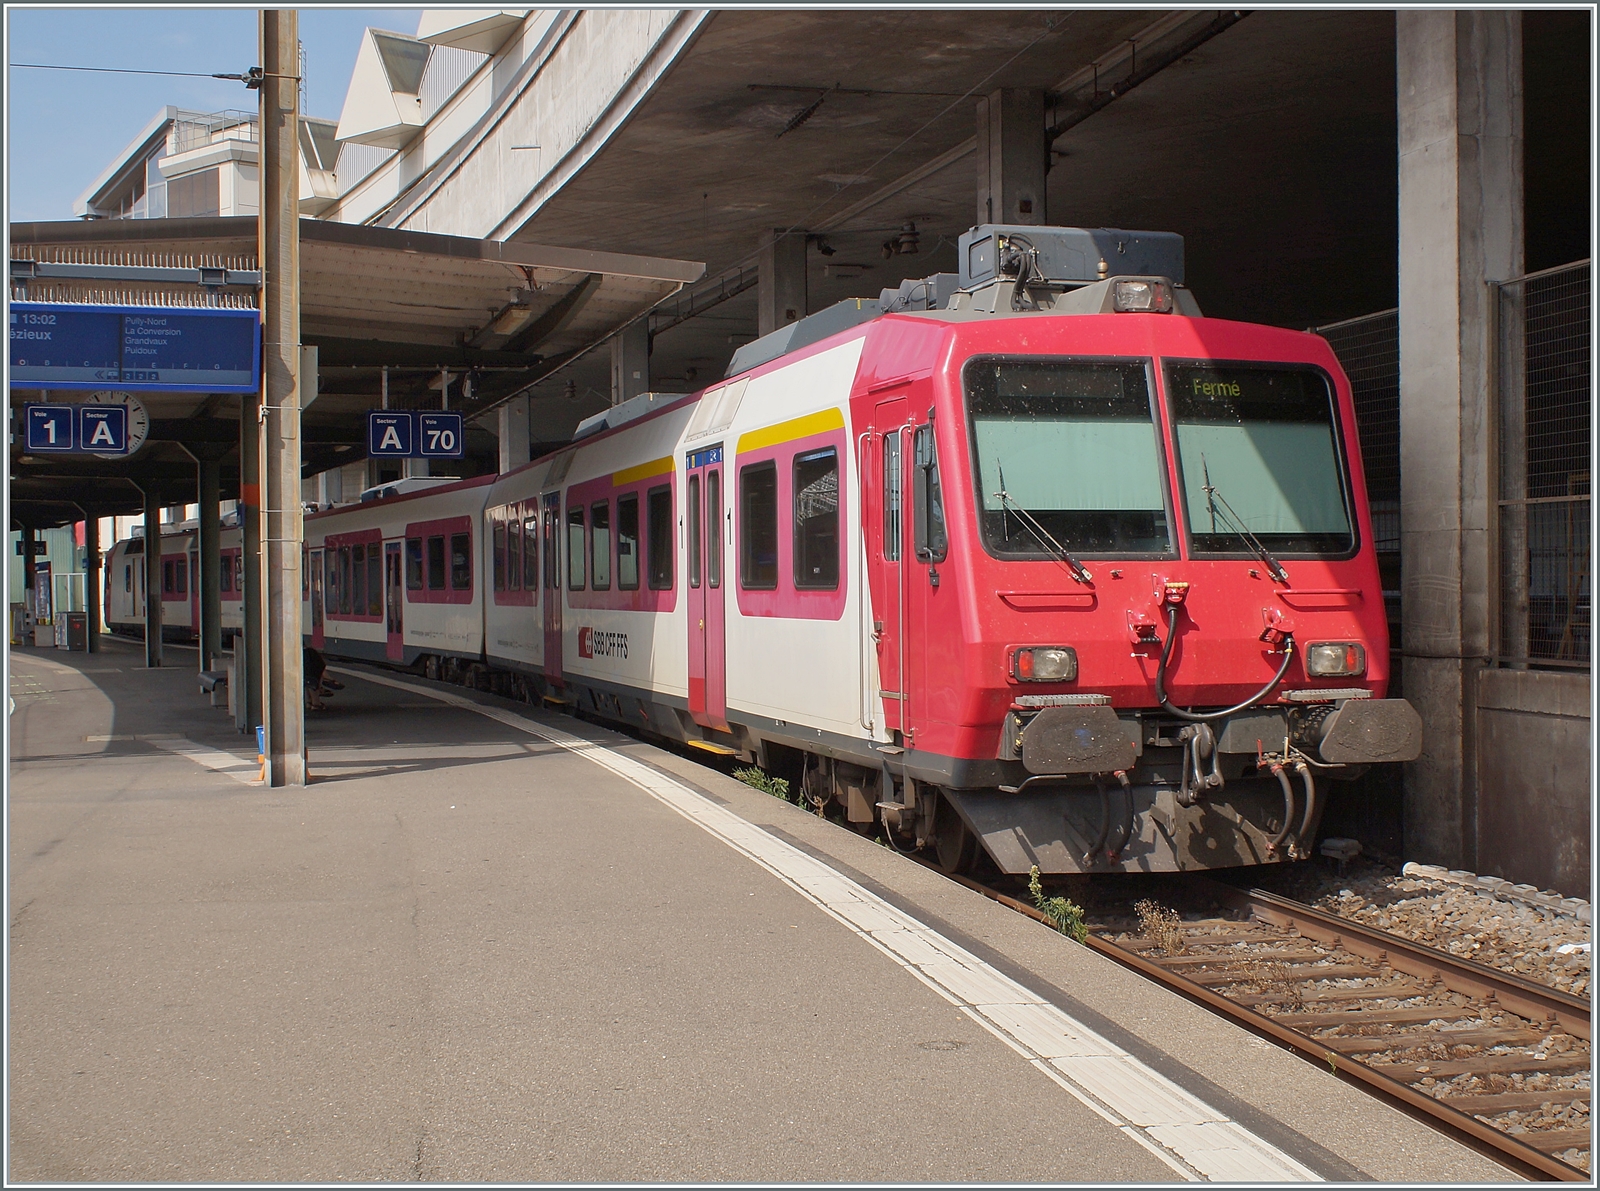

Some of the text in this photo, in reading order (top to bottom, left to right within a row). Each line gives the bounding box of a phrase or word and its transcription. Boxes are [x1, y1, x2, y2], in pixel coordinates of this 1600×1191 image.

[22, 314, 57, 325] 13:02
[125, 317, 167, 326] Pully-Nord
[125, 337, 168, 345] Grandvaux
[137, 327, 181, 336] Conversion
[1193, 378, 1241, 397] Fermé
[43, 419, 56, 444] 1
[90, 420, 115, 445] A
[380, 426, 402, 449] A
[427, 430, 455, 450] 70
[593, 631, 629, 659] SBB CFF FFS
